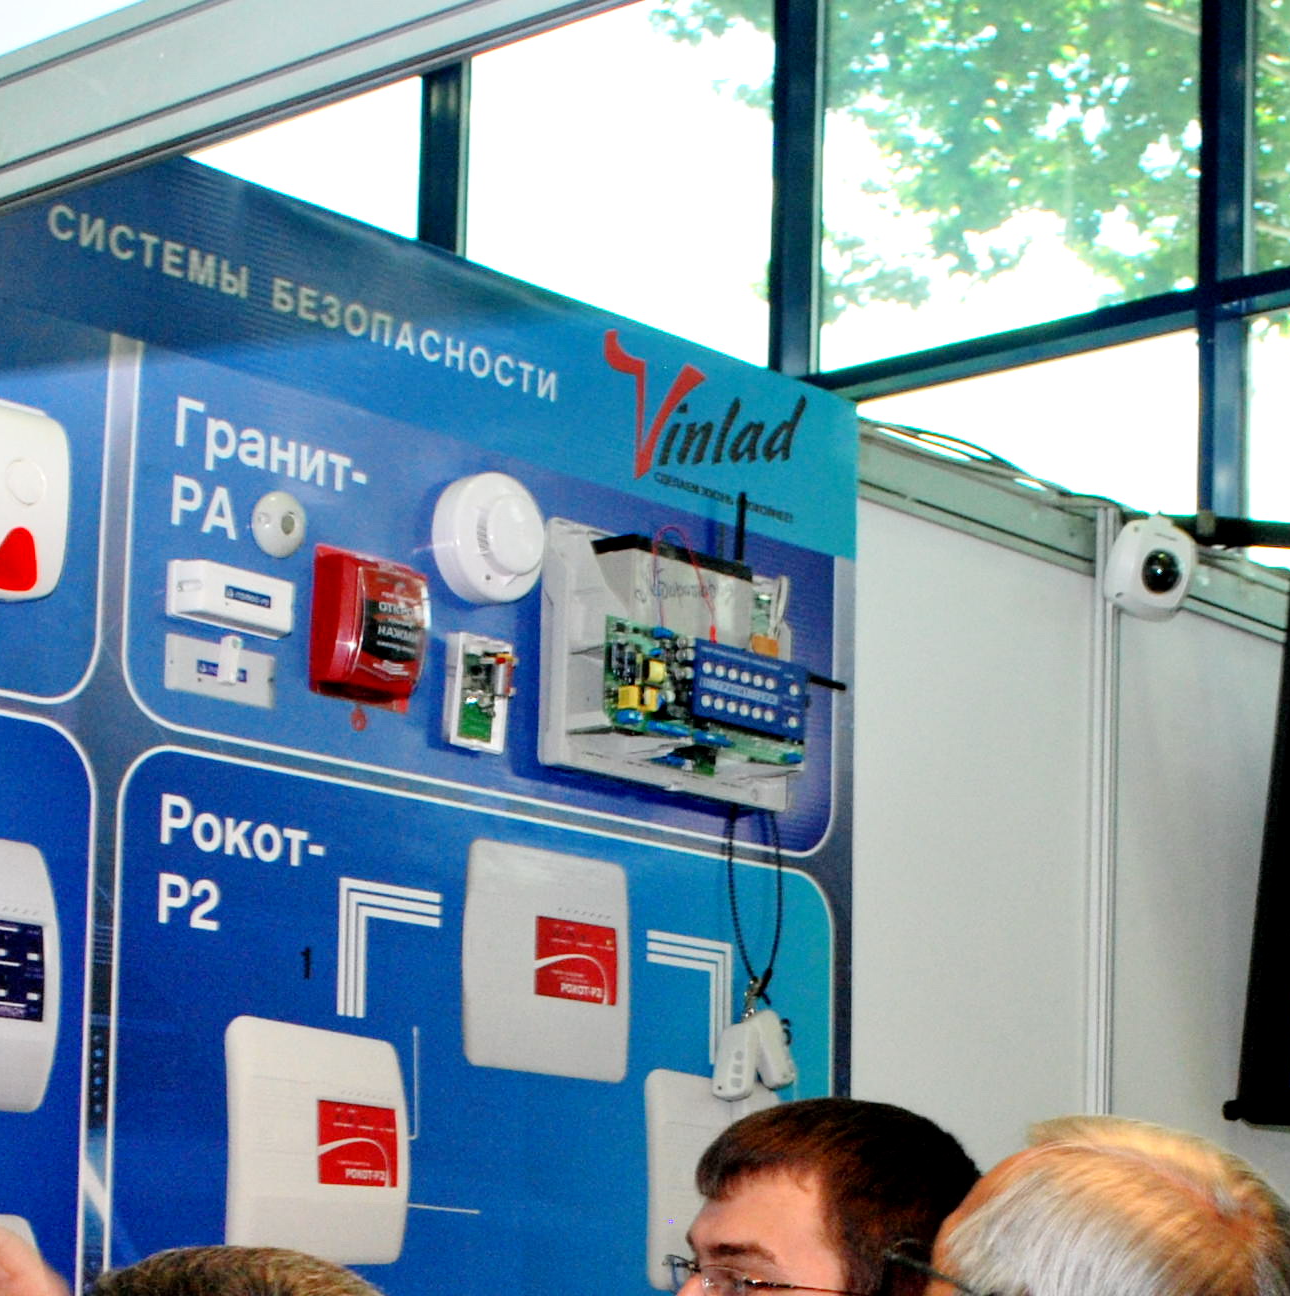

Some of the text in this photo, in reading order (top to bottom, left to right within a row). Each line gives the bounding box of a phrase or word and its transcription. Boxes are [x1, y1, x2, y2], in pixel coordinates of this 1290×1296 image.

[48, 204, 558, 403] СИСТЕМЫ БЕЗОПАСНОСТИ
[175, 395, 368, 492] Гранит-
[604, 329, 807, 480] Vinlad
[171, 475, 237, 541] РА
[158, 872, 221, 931] Р2
[301, 946, 313, 980] 1
